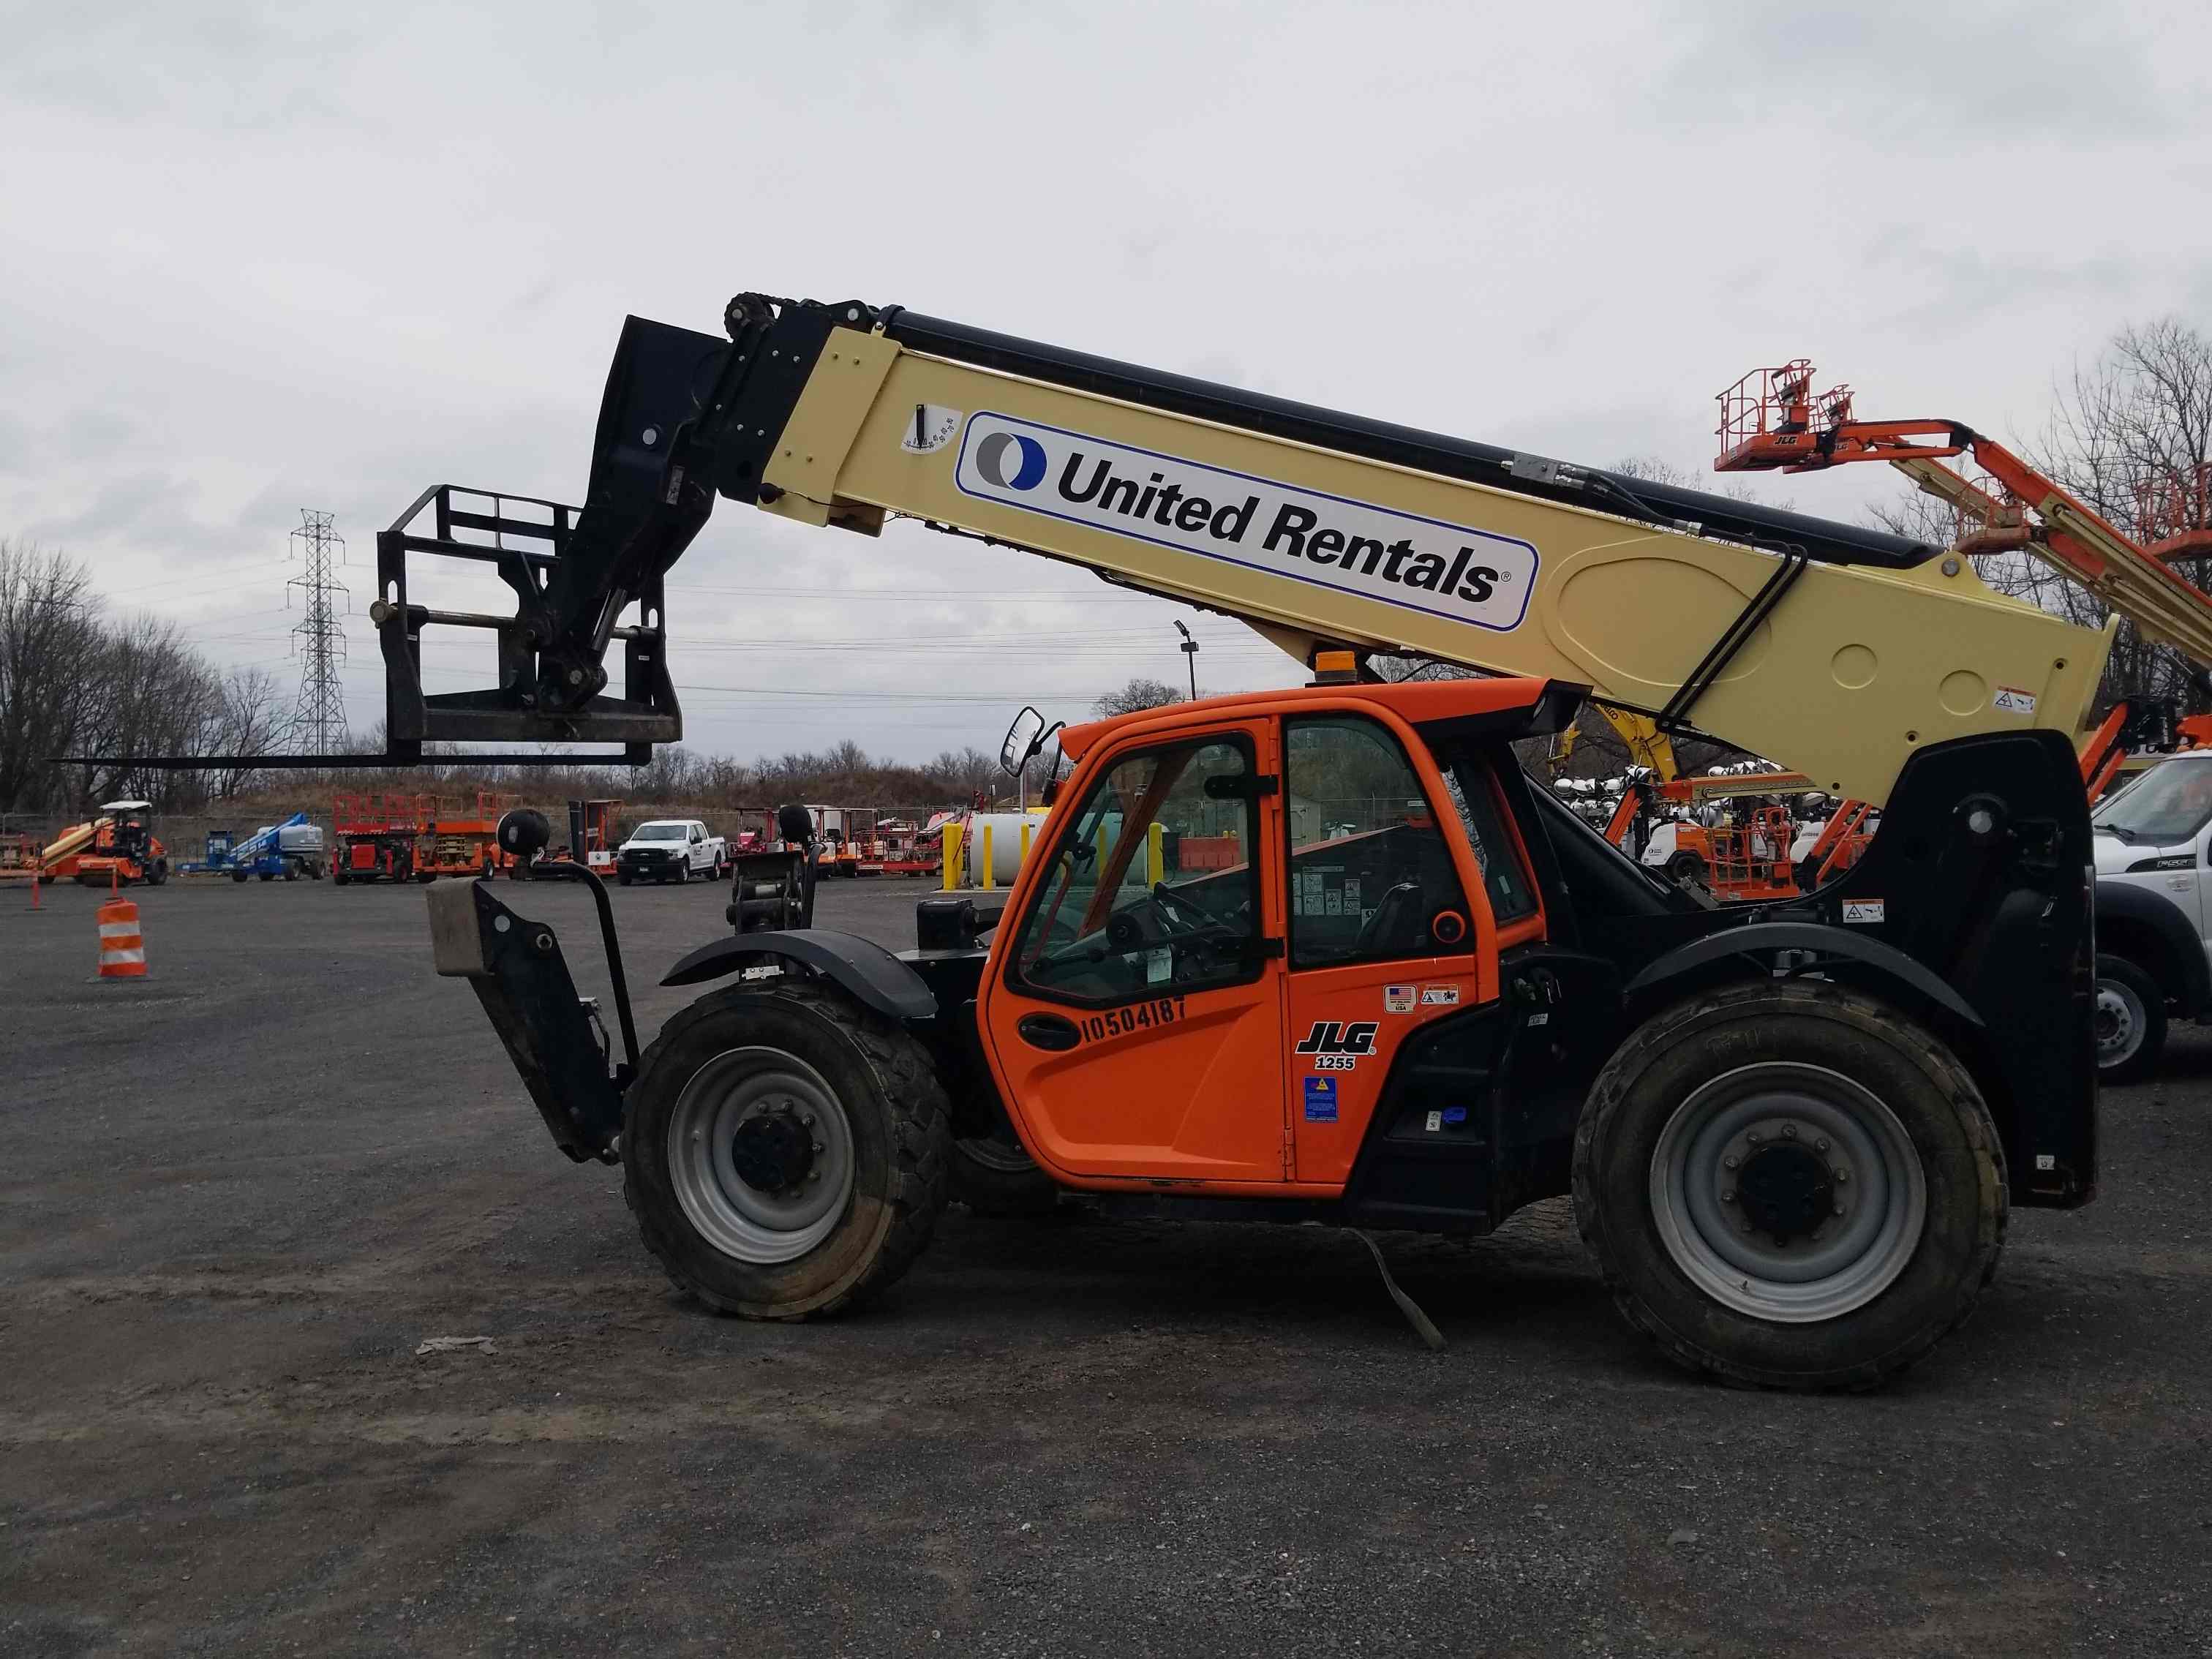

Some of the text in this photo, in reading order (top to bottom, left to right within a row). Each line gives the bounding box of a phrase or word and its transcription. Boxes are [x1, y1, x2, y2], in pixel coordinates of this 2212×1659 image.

[1775, 435, 1797, 445] JLG
[1058, 452, 1500, 603] United Rentals
[1081, 995, 1186, 1042] 10504187
[1295, 1022, 1380, 1054] JLG
[1315, 1056, 1355, 1069] 1255
